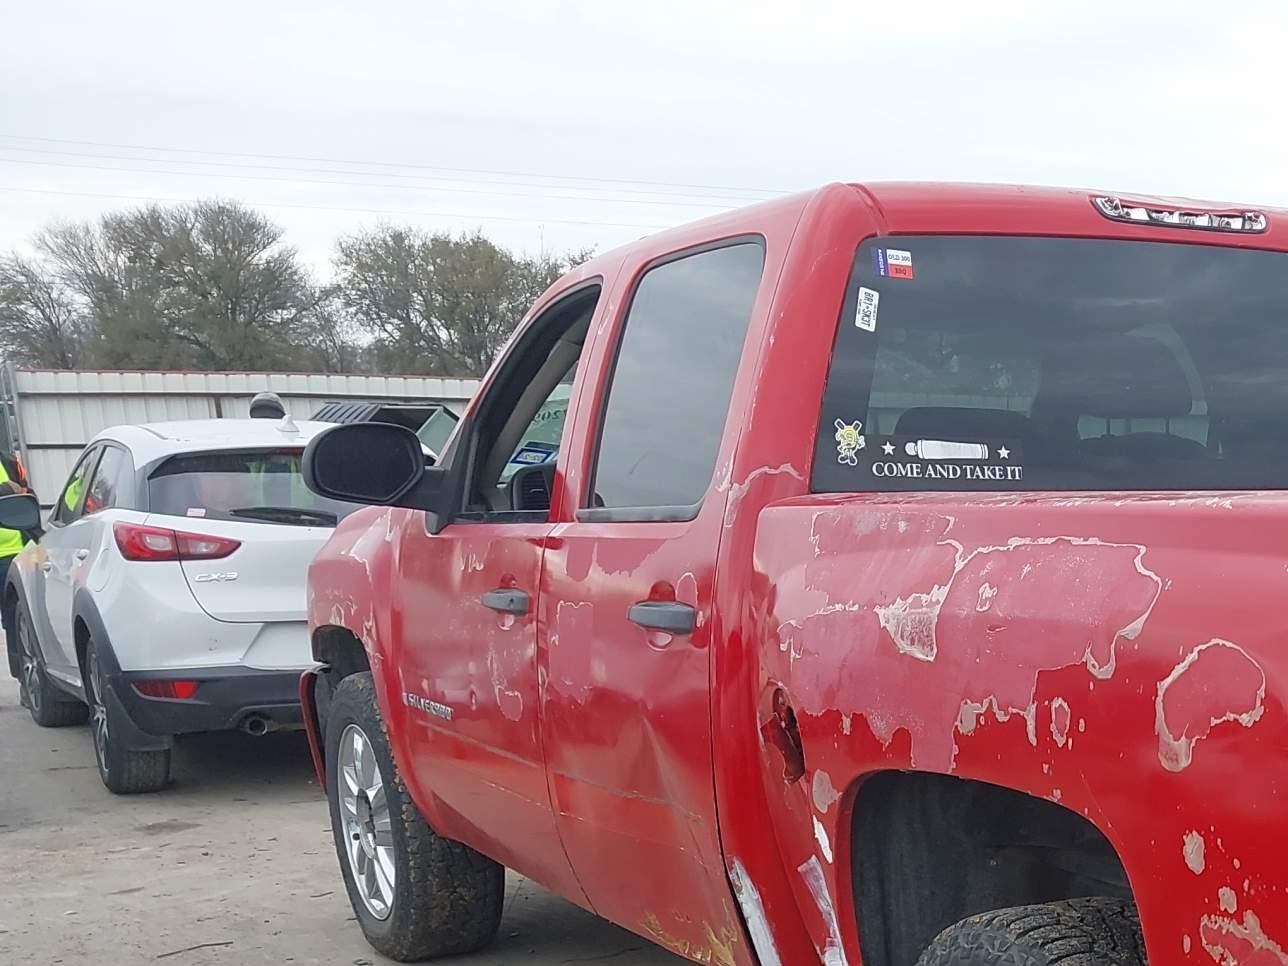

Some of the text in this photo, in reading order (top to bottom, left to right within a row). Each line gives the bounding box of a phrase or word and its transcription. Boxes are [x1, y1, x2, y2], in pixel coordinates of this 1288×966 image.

[872, 462, 1023, 480] COME AND TAKE IT
[195, 571, 239, 582] CX-3
